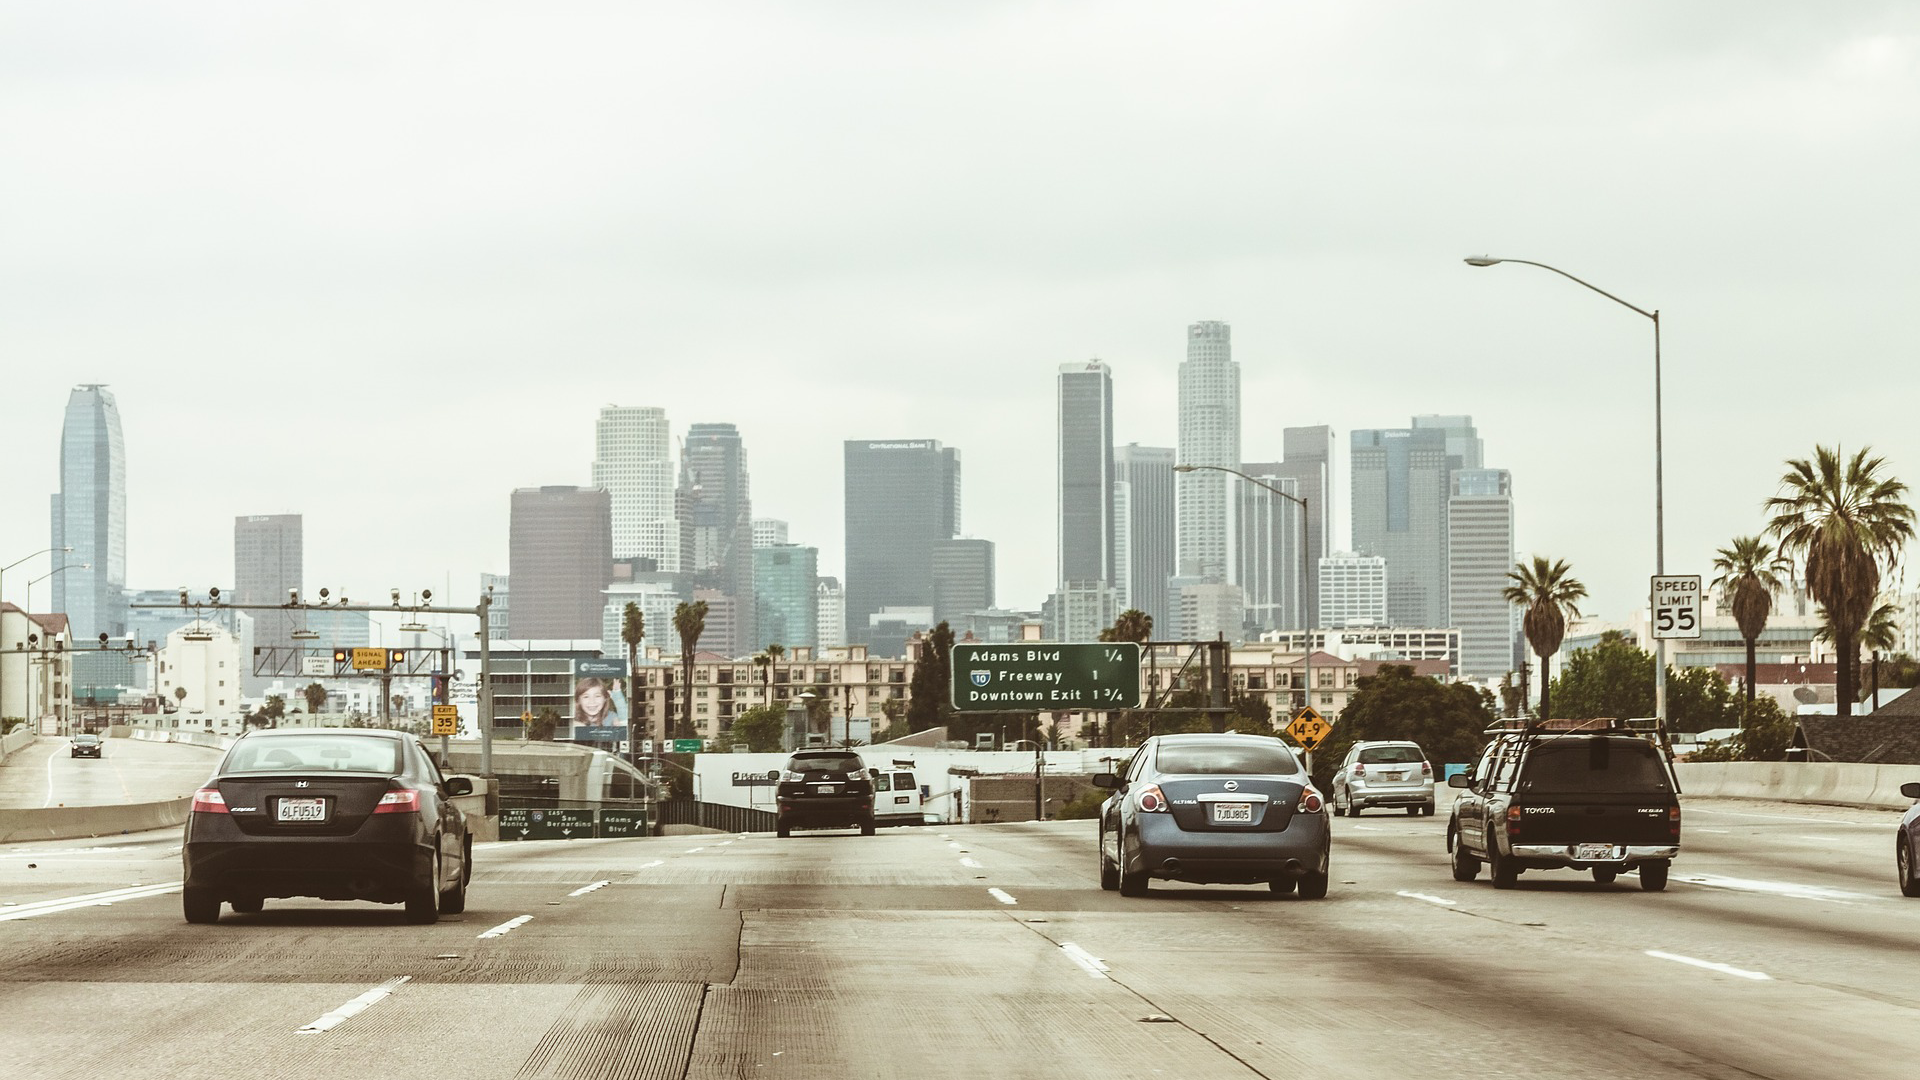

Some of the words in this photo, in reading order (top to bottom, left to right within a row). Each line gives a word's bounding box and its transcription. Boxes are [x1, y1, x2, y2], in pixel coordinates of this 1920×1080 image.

[1656, 581, 1698, 592] SPEED
[1660, 595, 1692, 606] LIMIT
[1657, 607, 1695, 632] 55
[970, 651, 1019, 662] Adams
[1027, 650, 1060, 661] Blvd
[976, 674, 987, 684] 10
[999, 671, 1062, 685] Freeway
[1093, 670, 1098, 680] 1
[970, 690, 1044, 702] Downtown
[1051, 689, 1081, 701] Exit
[438, 718, 453, 727] 35
[282, 806, 321, 817] 6LFU519
